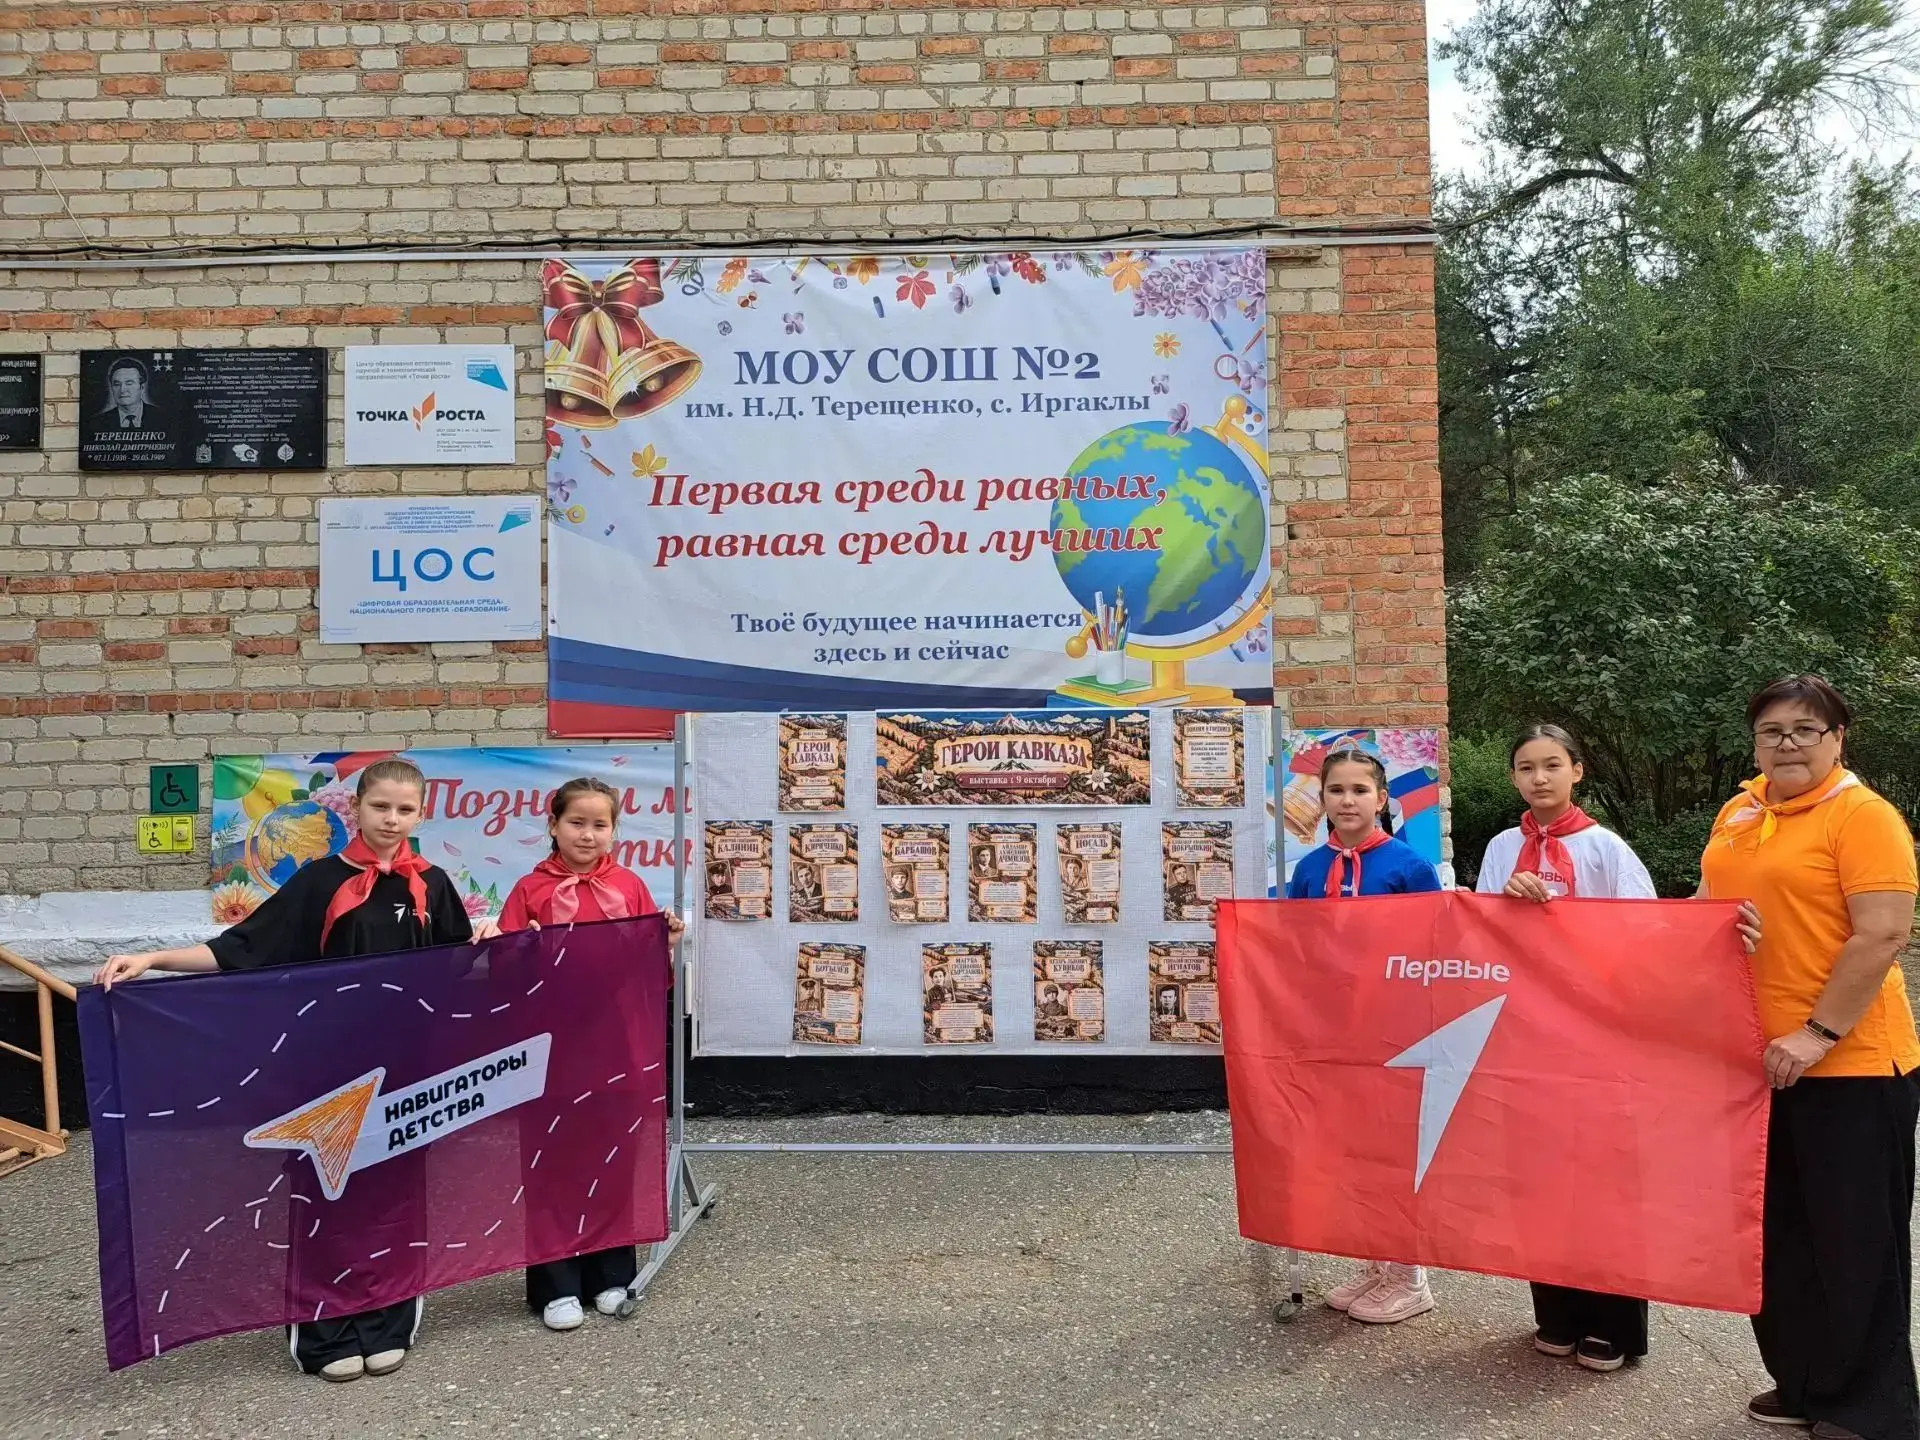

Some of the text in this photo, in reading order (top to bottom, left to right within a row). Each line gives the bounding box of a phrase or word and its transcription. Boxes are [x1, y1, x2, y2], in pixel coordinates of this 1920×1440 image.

[733, 346, 1101, 385] МОУ СОШ №2
[685, 392, 1151, 421] им. Н.Д. Терещенко, с. Иргаклы
[356, 410, 486, 422] ТОЧКА РОСТА
[93, 431, 166, 442] ТЕРЕЩЕНКО
[83, 443, 176, 451] НИКОЛАЙ ДМИТРИЕВИЧ
[646, 467, 1168, 515] Первая среди равных,
[652, 520, 1164, 568] равная среди лучших
[372, 546, 495, 591] ЦОС
[730, 609, 1083, 637] Твоё будущее начинается
[813, 640, 1010, 664] здесь и сейчас
[796, 741, 831, 753] ГЕРОИ
[941, 740, 1088, 769] ГЕРОИ КАВКАЗА
[791, 752, 835, 765] КАВКАЗА
[969, 777, 1008, 785] выставка
[1016, 775, 1022, 784] 9
[1023, 775, 1057, 787] октября
[717, 843, 759, 854] КАЛИНИН
[895, 846, 937, 856] БАРБАШОВ
[1076, 839, 1108, 849] НОСАЛЬ
[815, 964, 849, 975] БОТЫЛЁВ
[1168, 963, 1201, 972] ИГНАТОВ
[1385, 955, 1511, 987] Первые
[384, 1050, 527, 1124] НАВИГАТОРЫ
[387, 1092, 485, 1151] ДЕТСТВА
